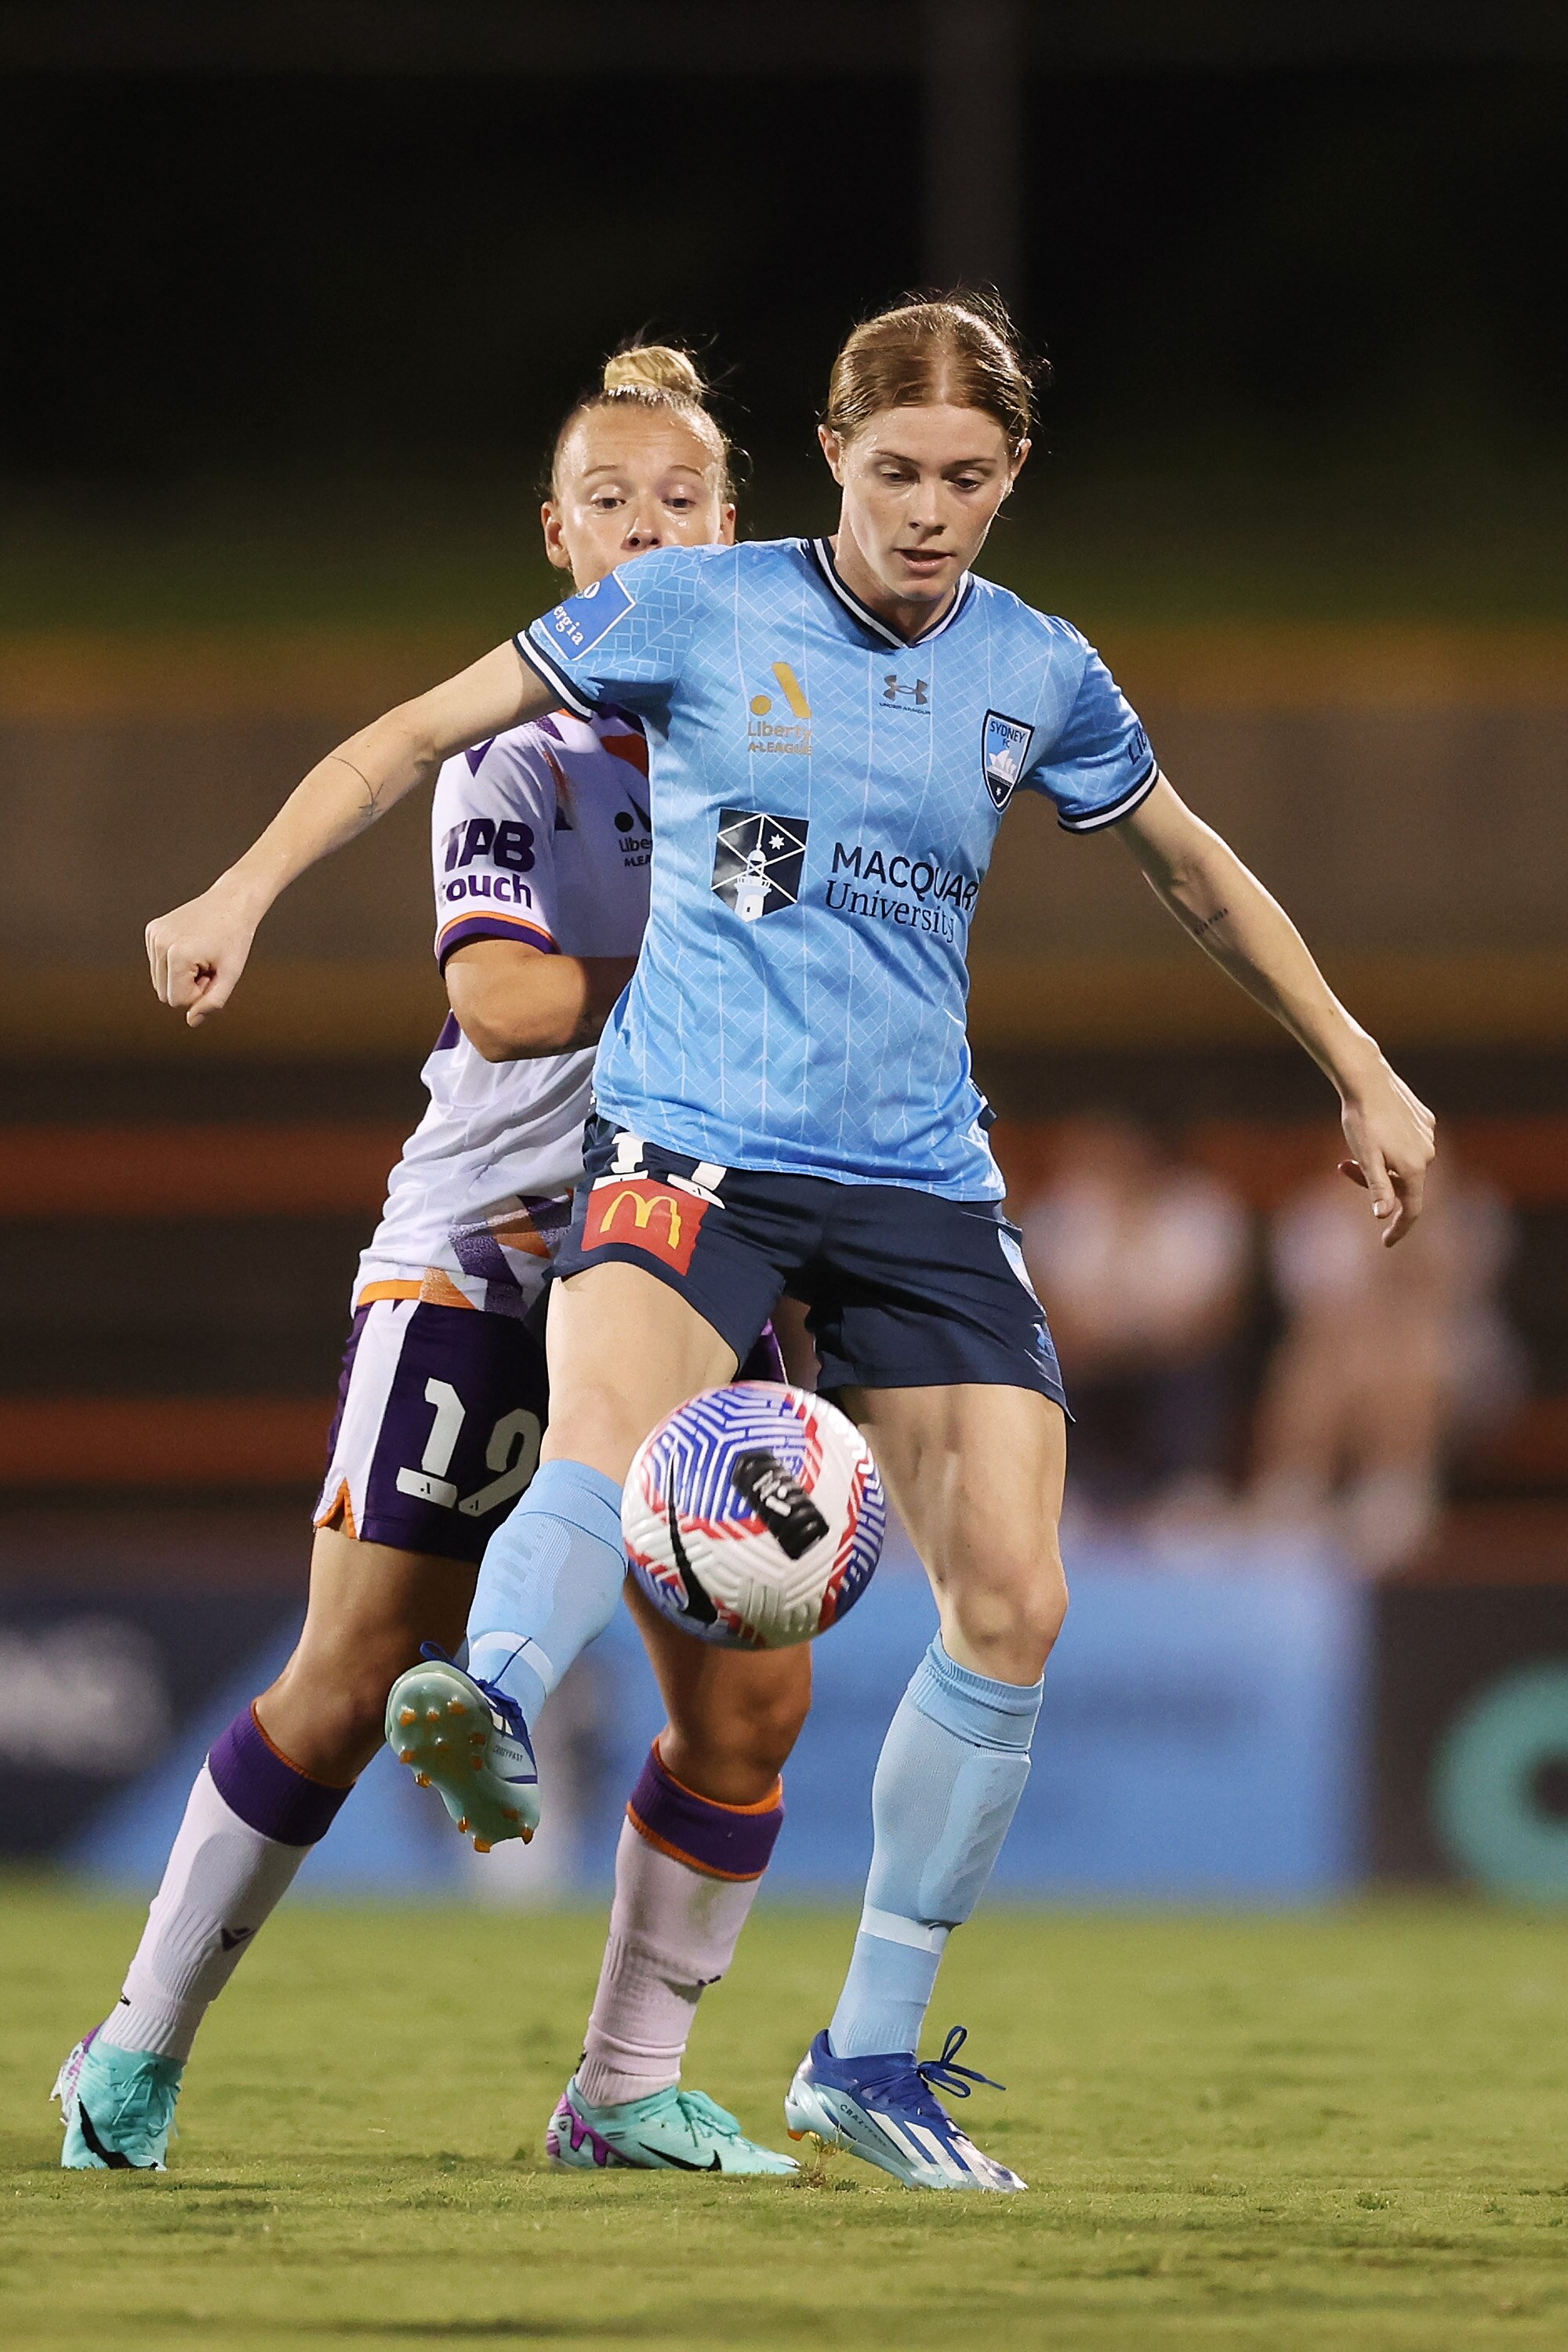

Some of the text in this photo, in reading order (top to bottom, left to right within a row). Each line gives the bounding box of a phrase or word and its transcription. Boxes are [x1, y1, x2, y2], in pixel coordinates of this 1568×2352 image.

[553, 605, 584, 646] ergia
[747, 720, 811, 744] Liberty
[989, 720, 1025, 744] SYDNEY
[1002, 738, 1011, 749] FC
[441, 818, 535, 873] TAB
[437, 873, 532, 909] ouch
[826, 880, 954, 943] University
[396, 1377, 542, 1517] 19
